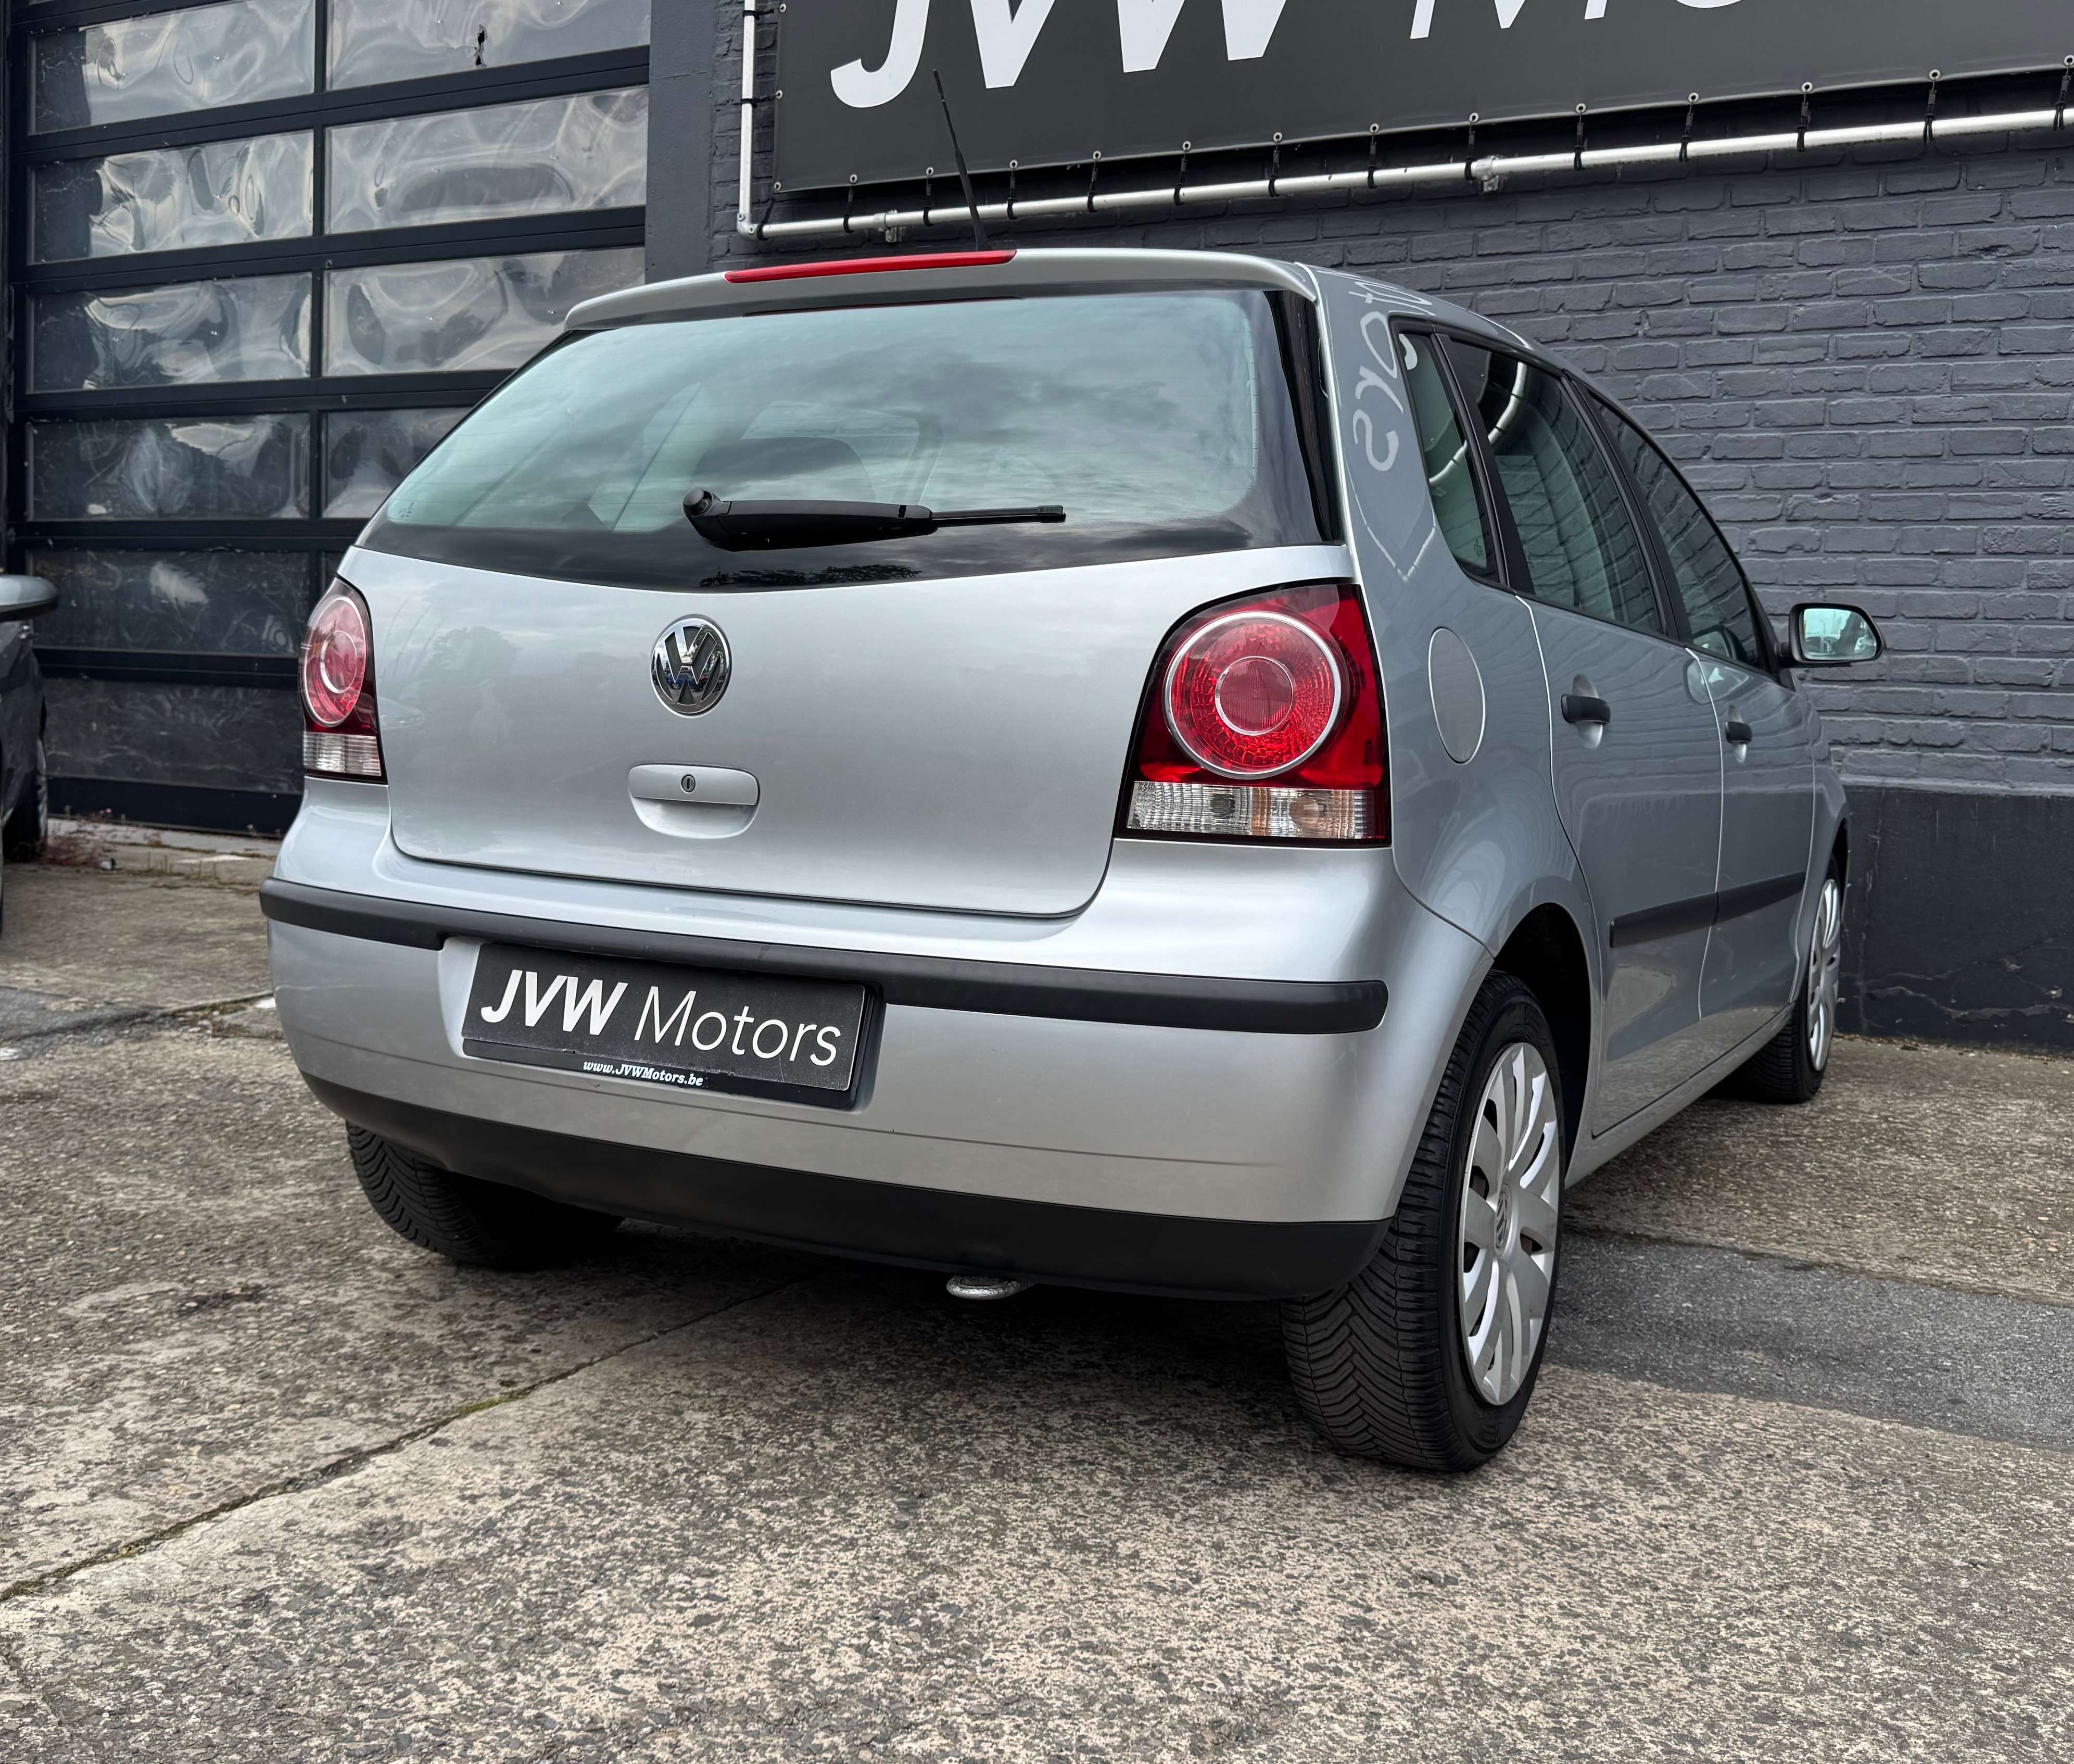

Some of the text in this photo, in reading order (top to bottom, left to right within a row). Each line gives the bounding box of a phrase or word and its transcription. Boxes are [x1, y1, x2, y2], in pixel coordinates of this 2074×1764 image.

[480, 969, 842, 1066] JVW Motors
[583, 1061, 704, 1087] www.JVWMotors.be
